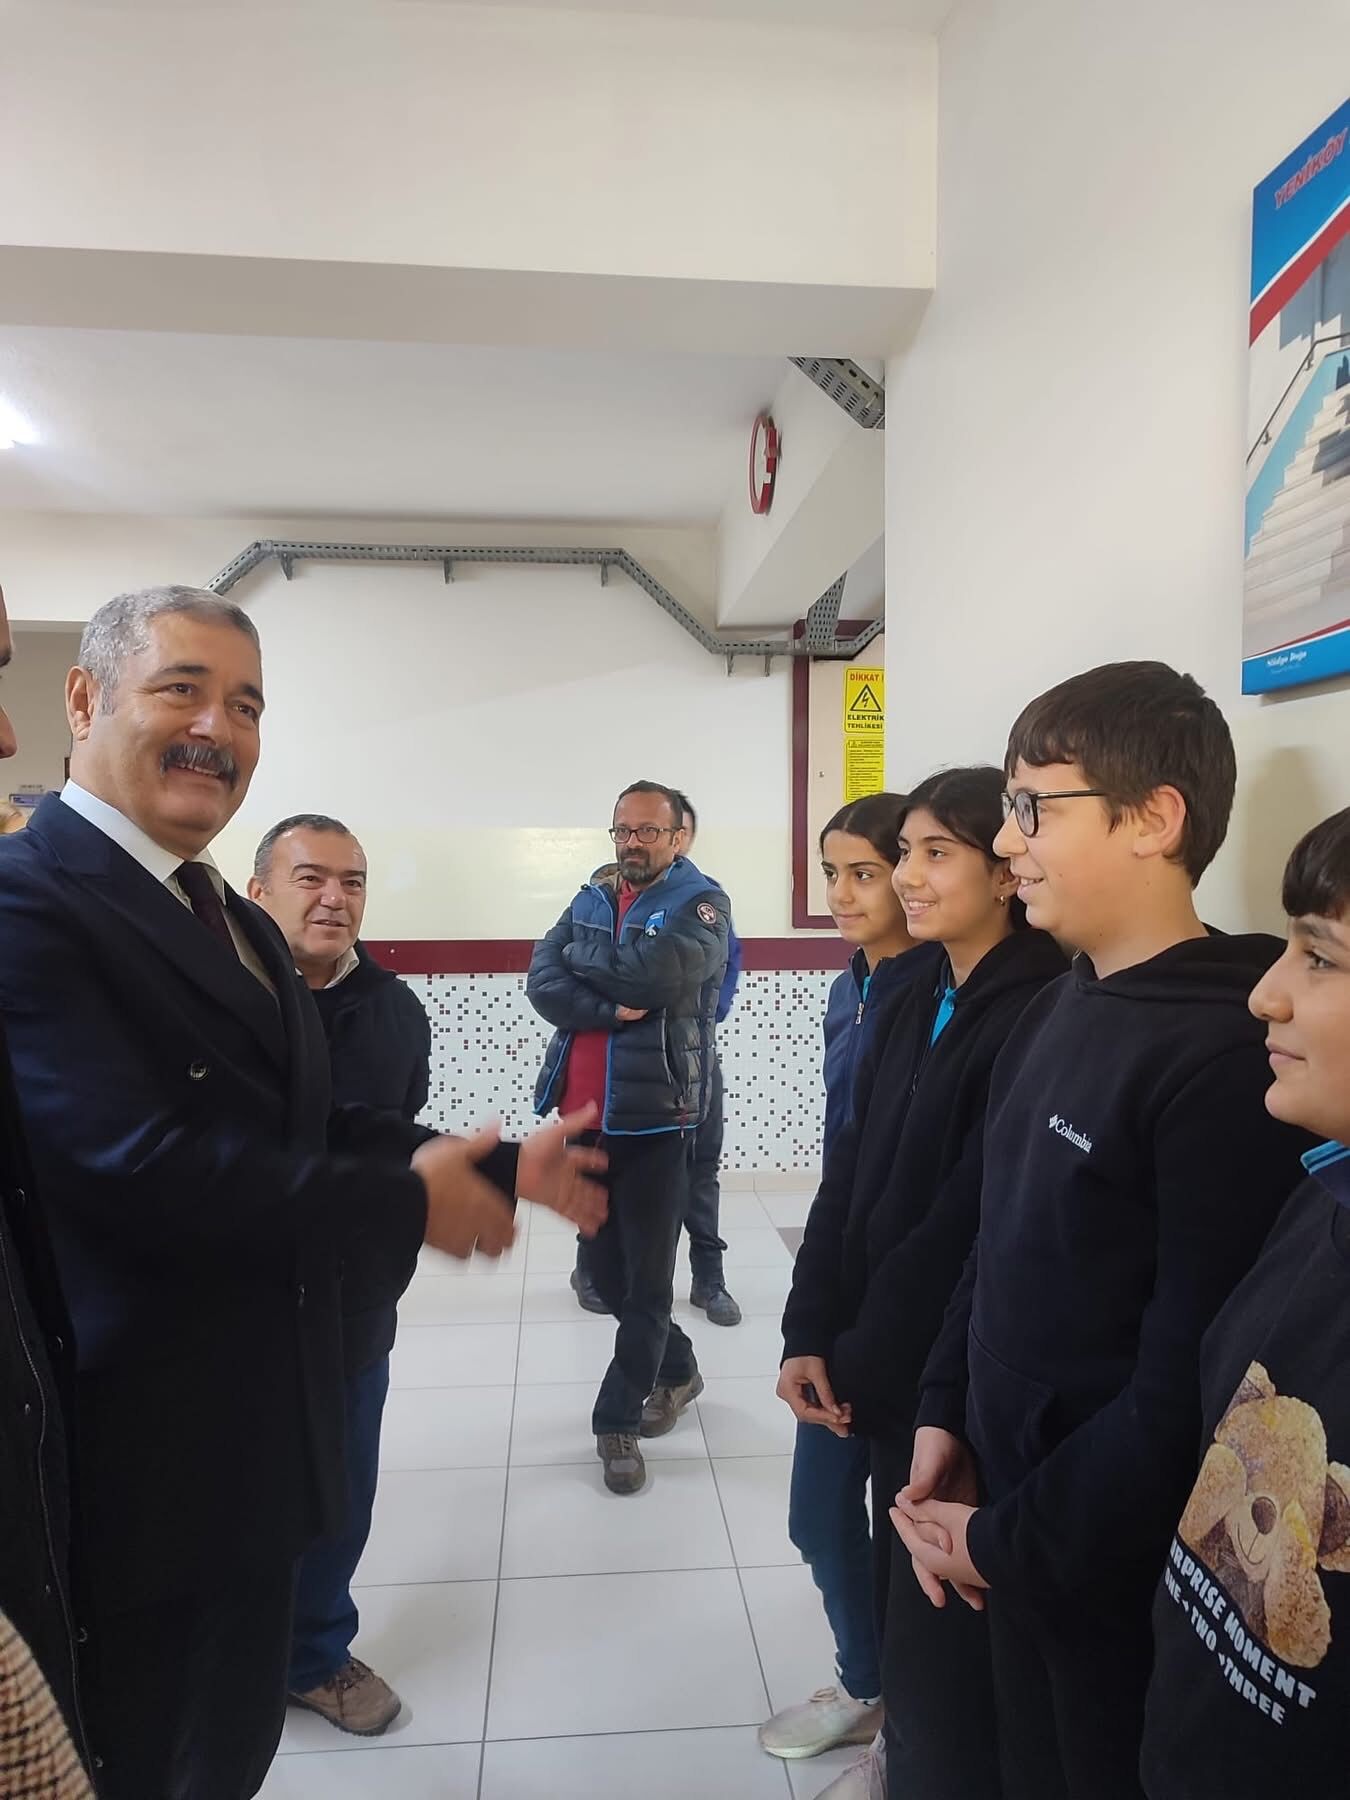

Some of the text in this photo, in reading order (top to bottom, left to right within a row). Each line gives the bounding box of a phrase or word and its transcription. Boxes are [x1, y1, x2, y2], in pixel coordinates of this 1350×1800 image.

[850, 672, 879, 681] DİKKAT
[847, 713, 885, 721] ELEKTRİK
[847, 722, 883, 730] TEHLİKESİ
[1055, 1118, 1093, 1154] Columbia
[1223, 1610, 1317, 1709] MOMENT
